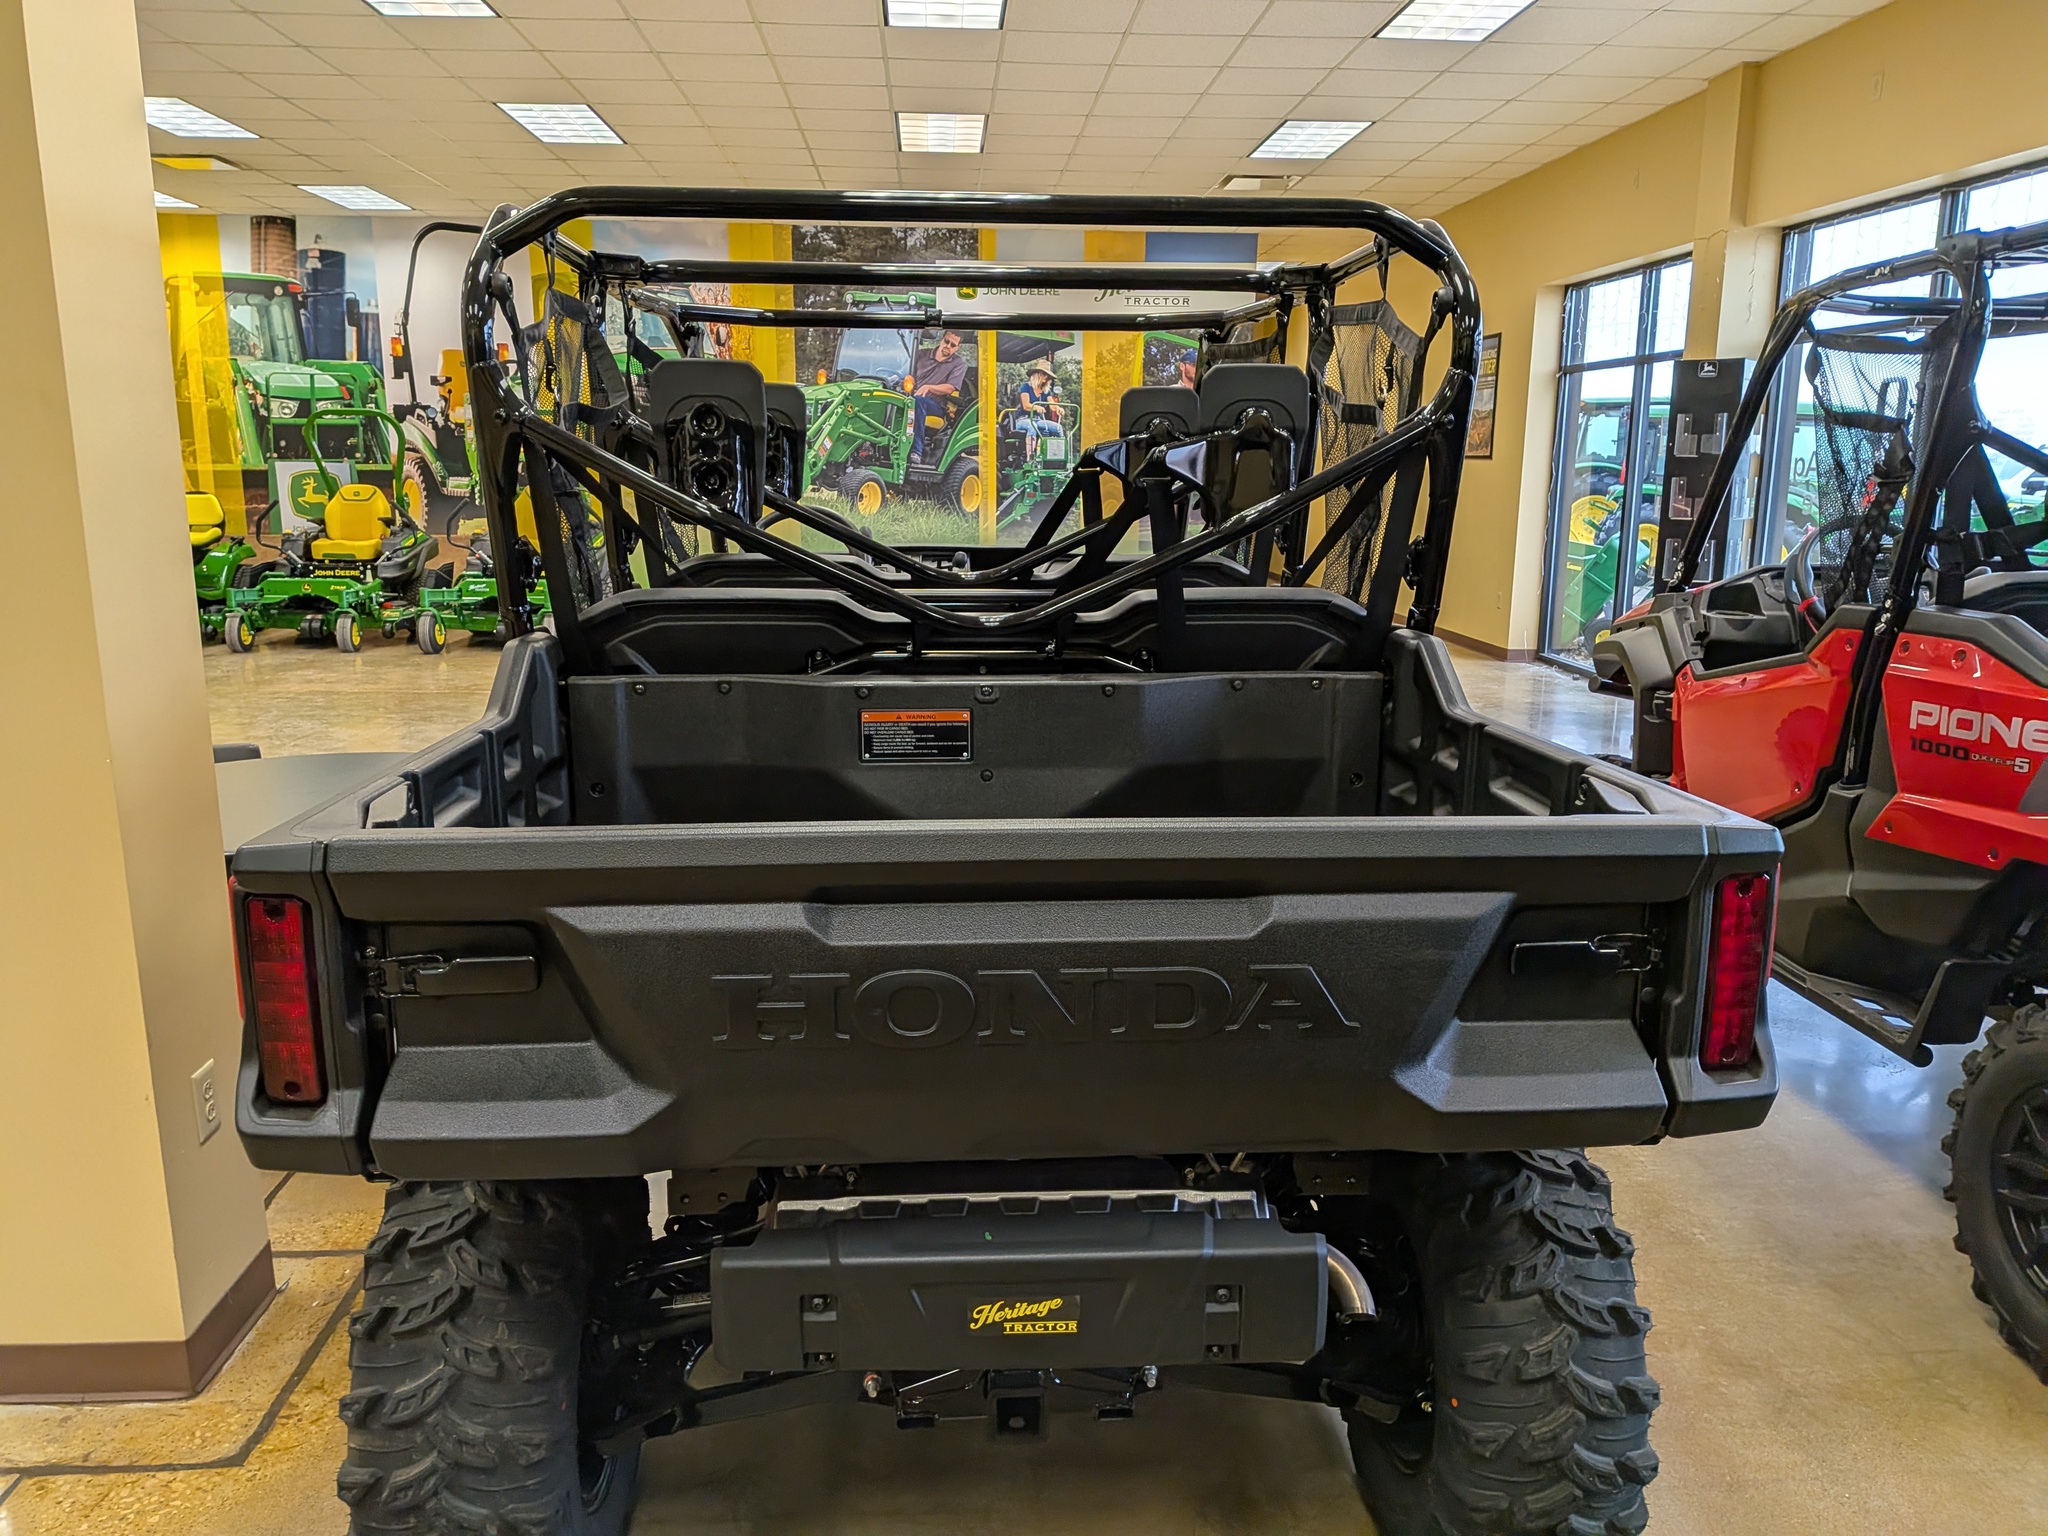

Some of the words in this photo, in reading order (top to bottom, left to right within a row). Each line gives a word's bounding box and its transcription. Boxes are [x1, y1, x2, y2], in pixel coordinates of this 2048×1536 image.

[983, 287, 1017, 296] JOHN
[1019, 287, 1061, 296] DEERE
[1124, 297, 1190, 306] TRACTOR
[1910, 736, 1970, 760] 1000
[711, 966, 1362, 1048] HONDA
[970, 1298, 1063, 1330] Heritage
[1003, 1323, 1078, 1332] TRACTOR
